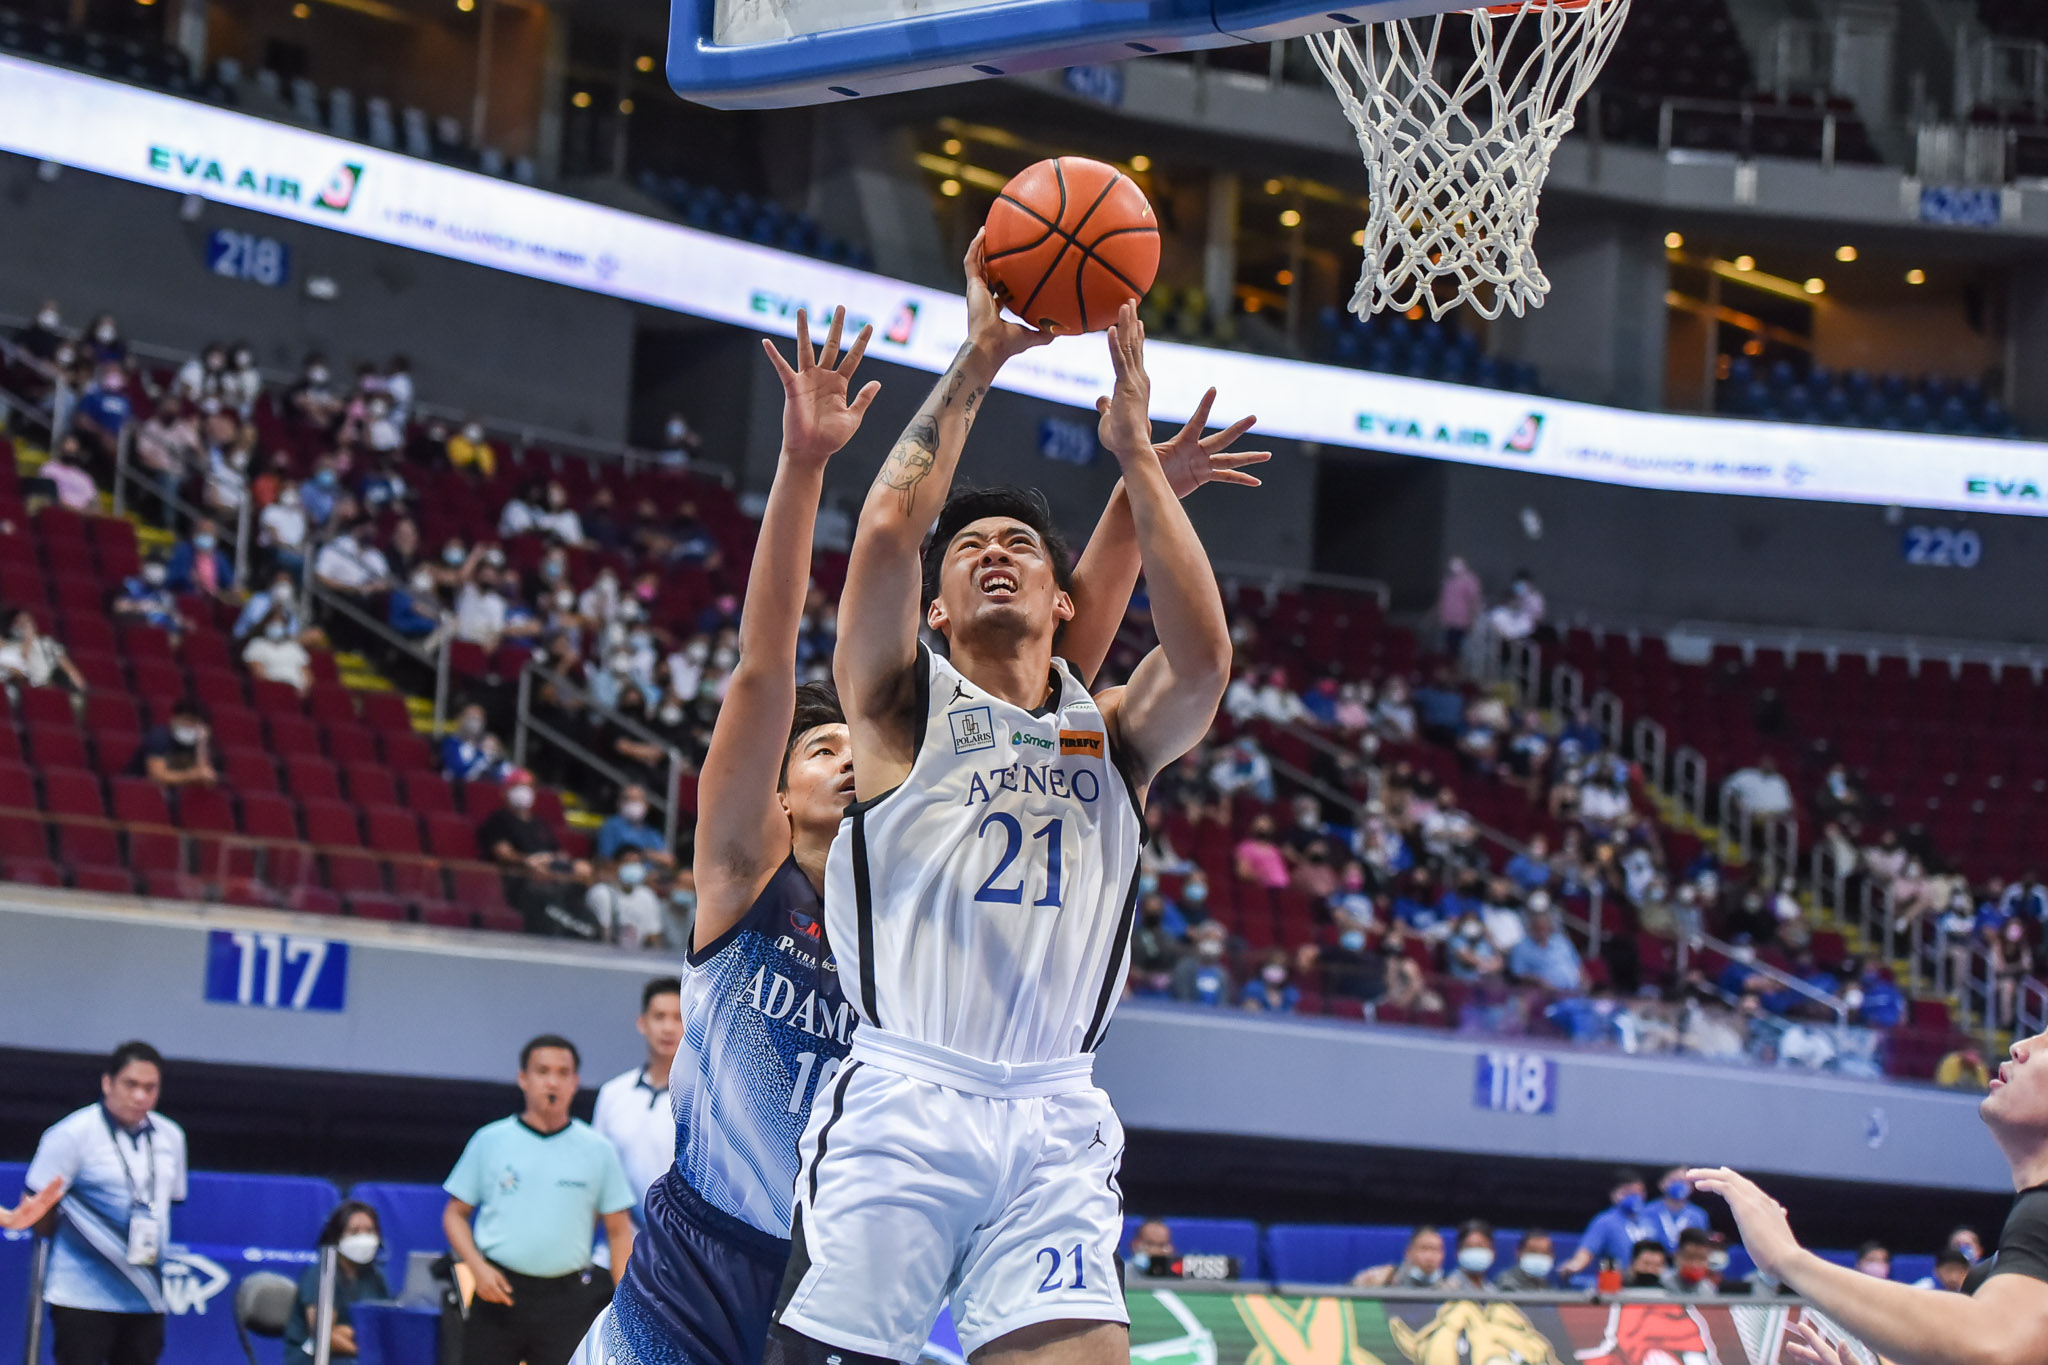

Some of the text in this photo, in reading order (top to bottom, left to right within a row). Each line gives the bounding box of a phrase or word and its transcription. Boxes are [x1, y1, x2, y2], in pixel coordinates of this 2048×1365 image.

[149, 147, 300, 200] EVA AIR
[213, 228, 284, 286] 218
[751, 293, 810, 322] EV
[1355, 413, 1422, 438] EVA
[1967, 479, 2040, 498] EVA
[1905, 525, 1982, 569] 220
[956, 732, 992, 746] POLARIS
[1060, 737, 1101, 750] FIREFLY
[965, 762, 1100, 807] ATENEO
[974, 811, 1063, 909] 21
[231, 931, 327, 1011] 117
[774, 935, 817, 966] PETRA
[1488, 1051, 1547, 1114] 118
[1036, 1243, 1087, 1294] 21
